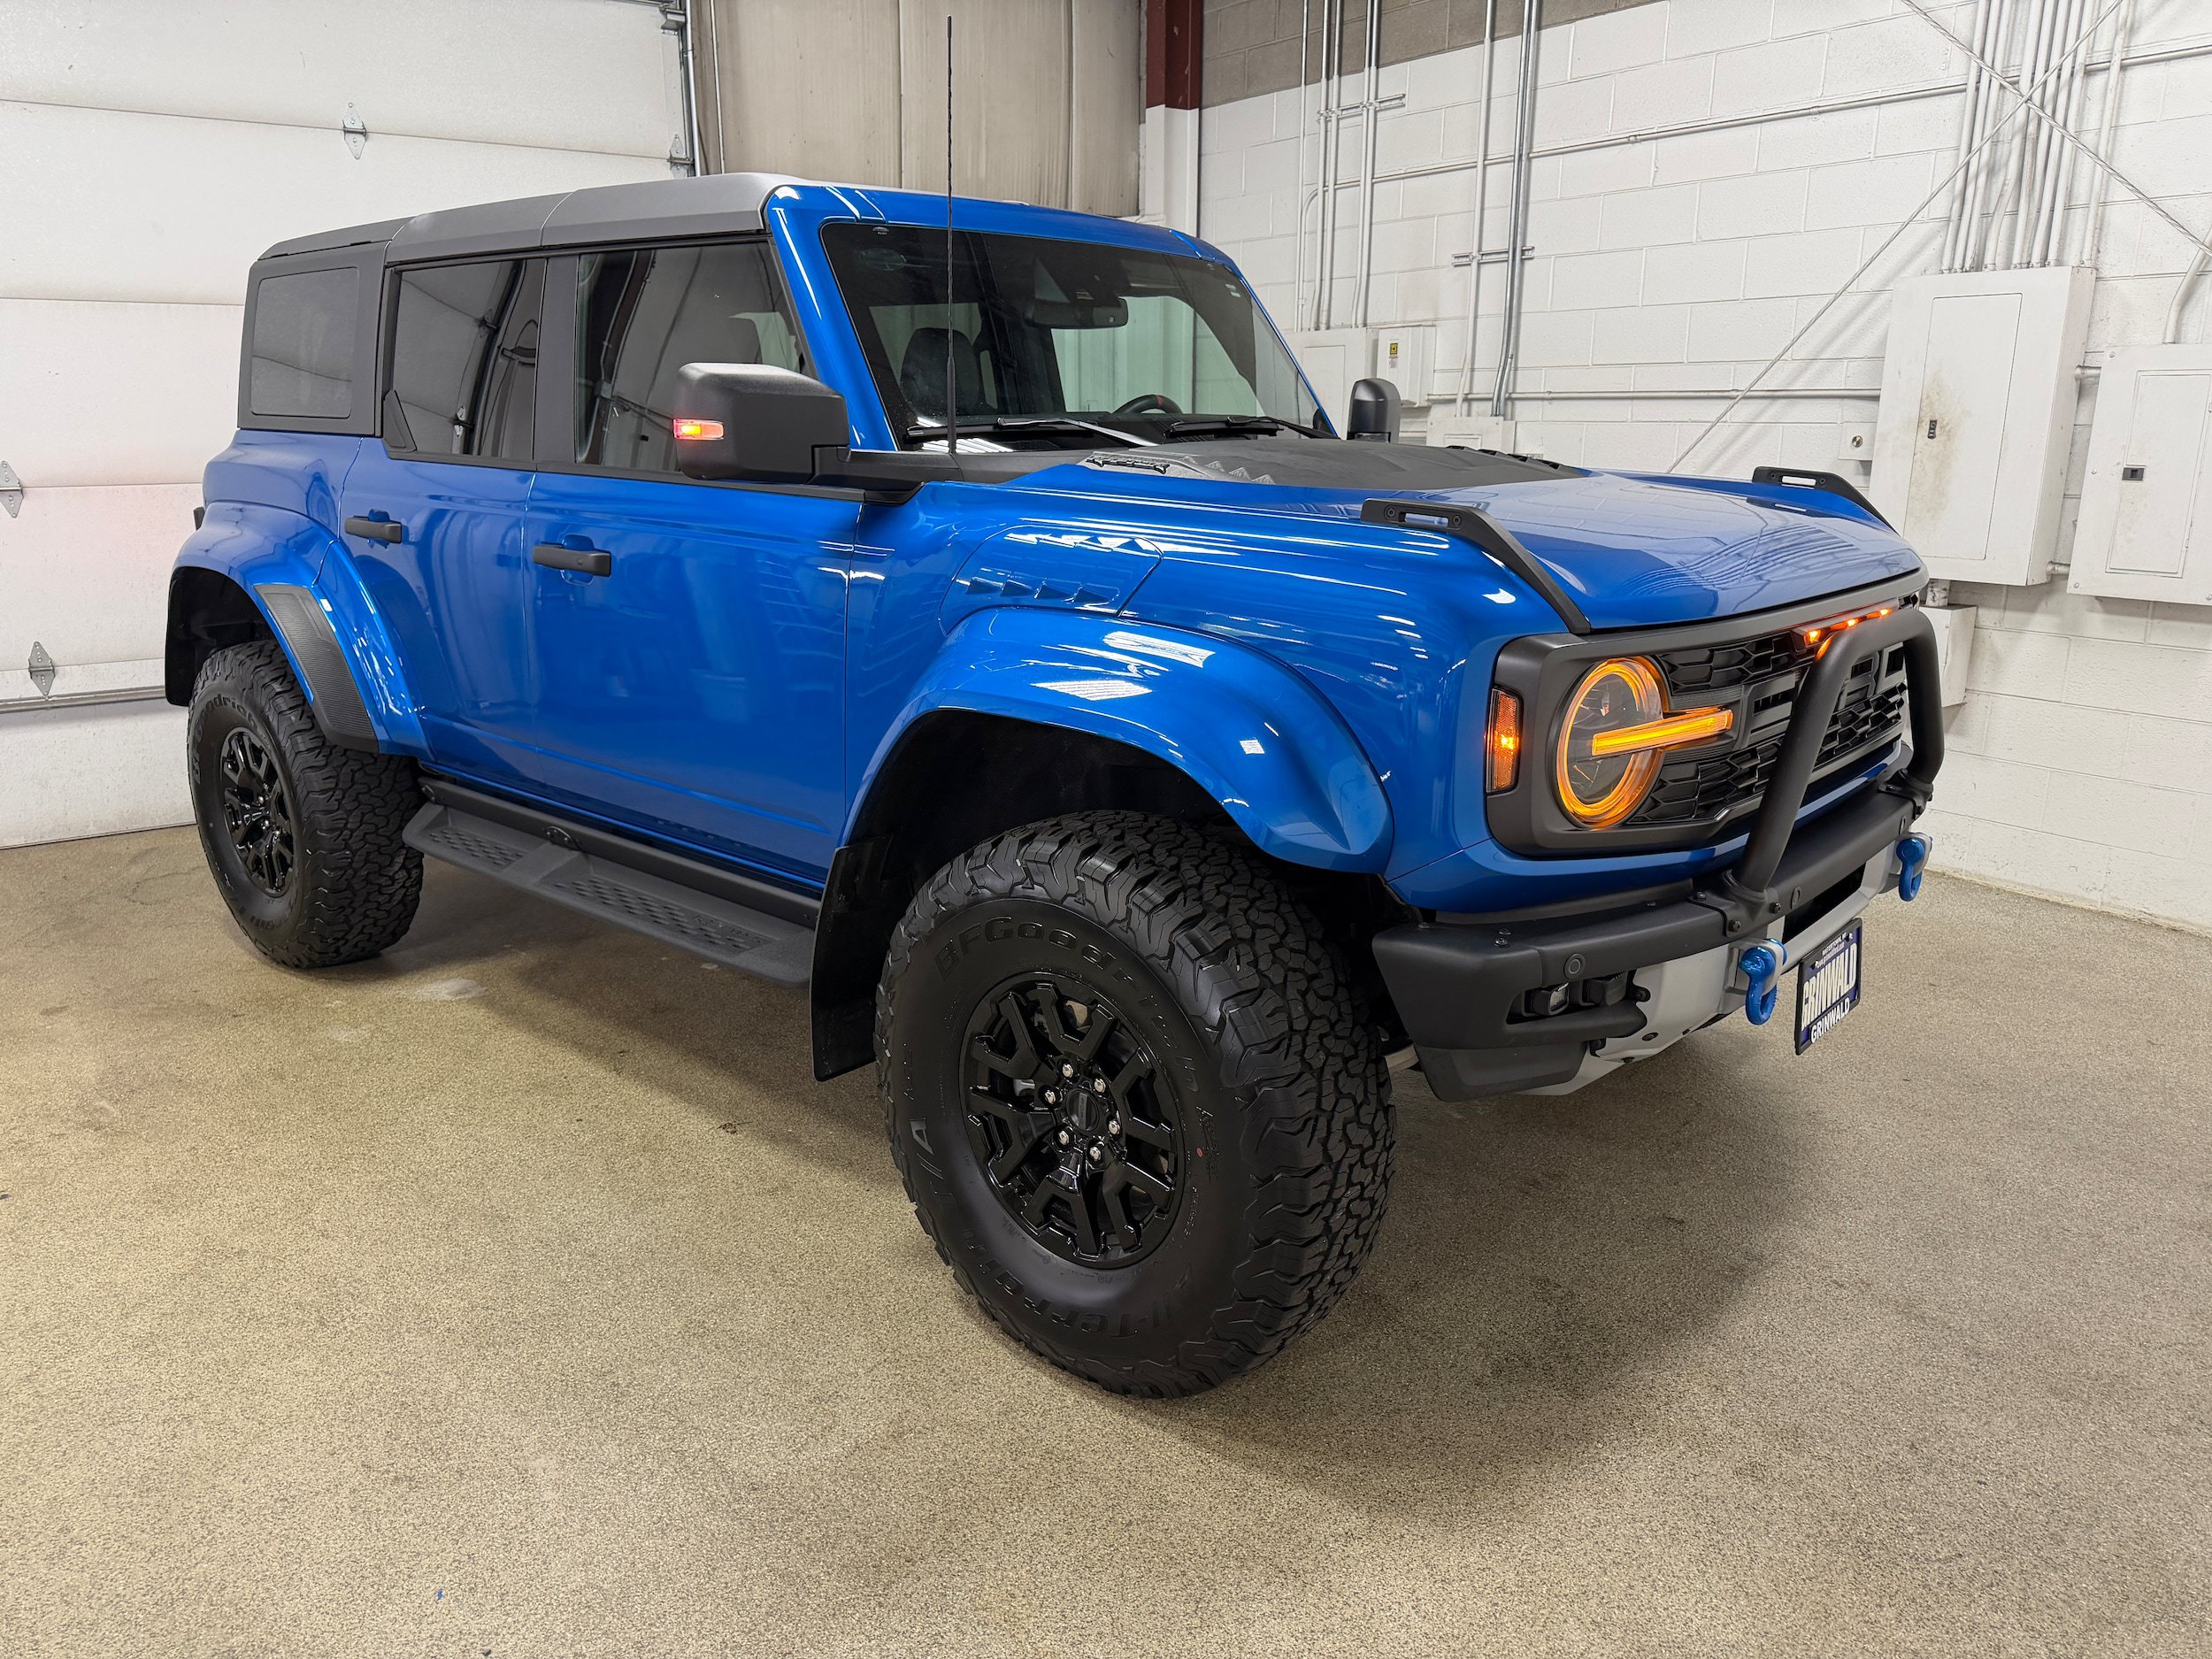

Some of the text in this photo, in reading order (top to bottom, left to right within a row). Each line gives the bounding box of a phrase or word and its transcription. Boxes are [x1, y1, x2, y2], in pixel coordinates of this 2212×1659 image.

[933, 915, 1201, 1094] BFGoodrich
[1801, 942, 1857, 1031] GRINWALD
[1810, 997, 1850, 1044] GRINWALD
